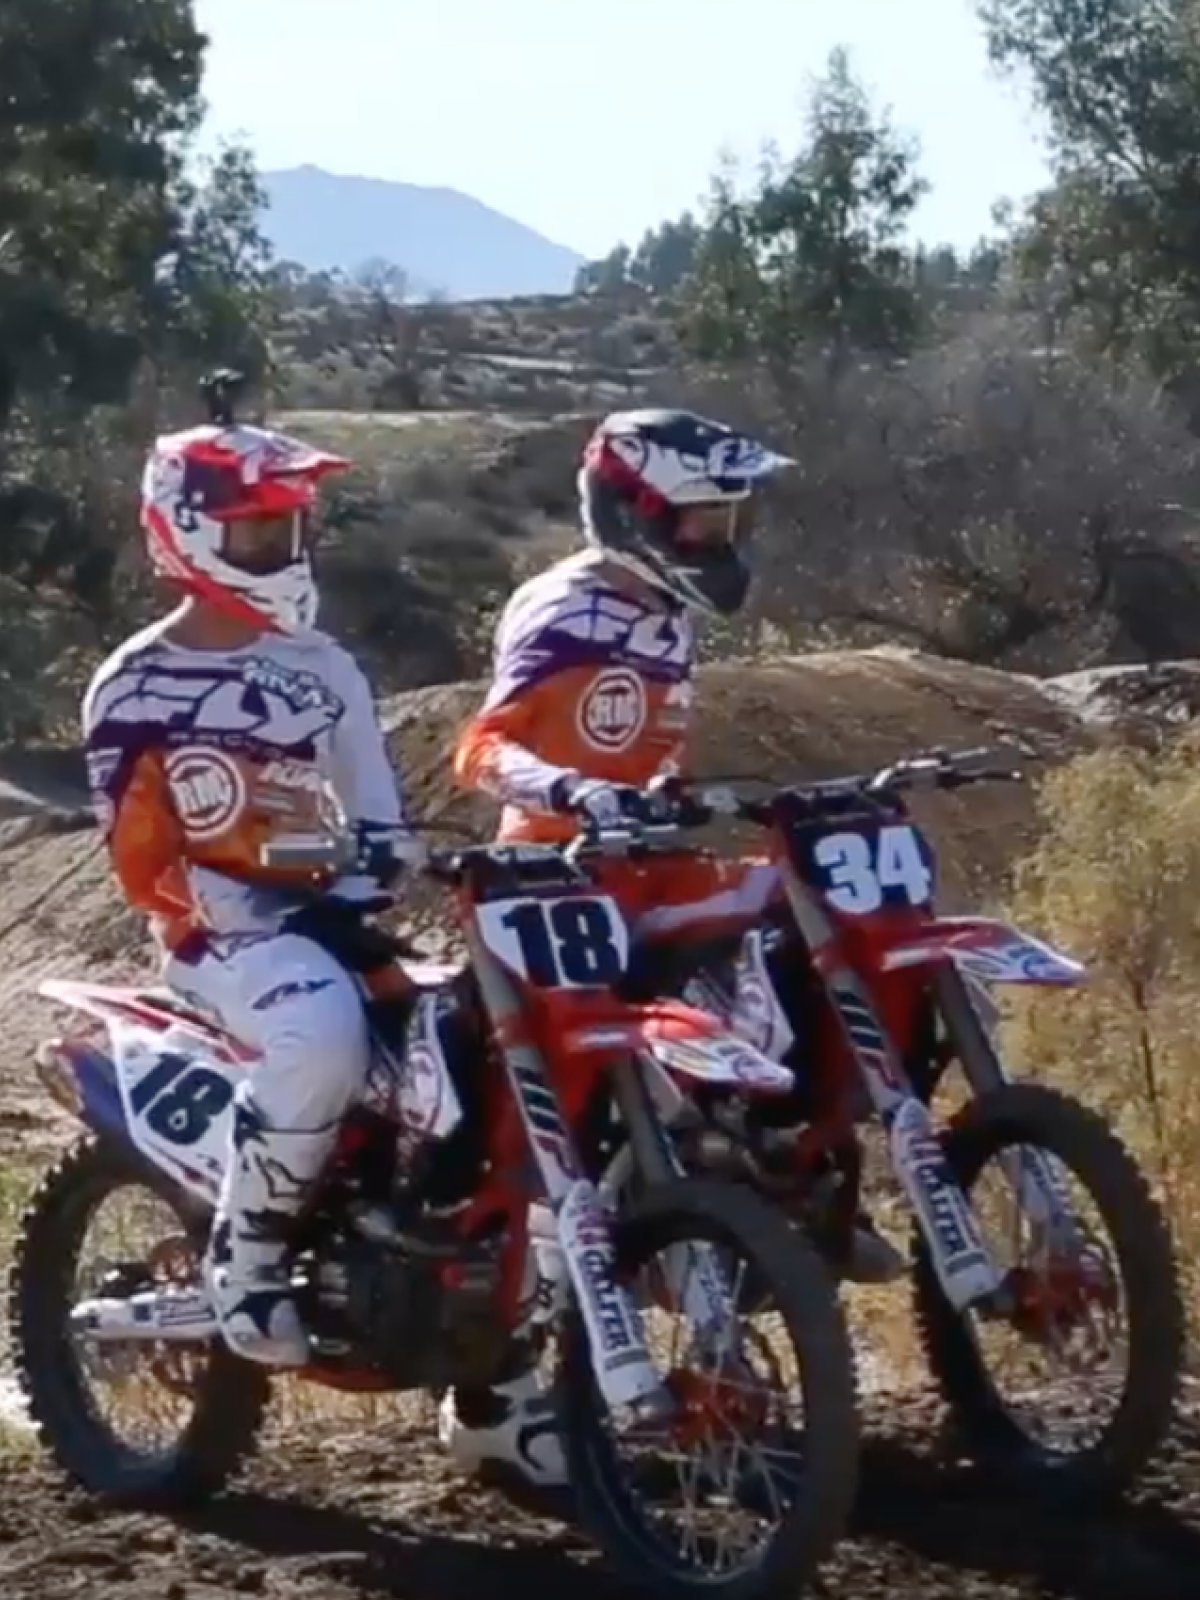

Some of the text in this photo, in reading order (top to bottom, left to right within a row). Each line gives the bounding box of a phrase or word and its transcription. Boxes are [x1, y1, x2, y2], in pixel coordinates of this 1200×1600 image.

[813, 825, 932, 915] 34
[501, 899, 616, 988] 18
[130, 1051, 235, 1145] 18
